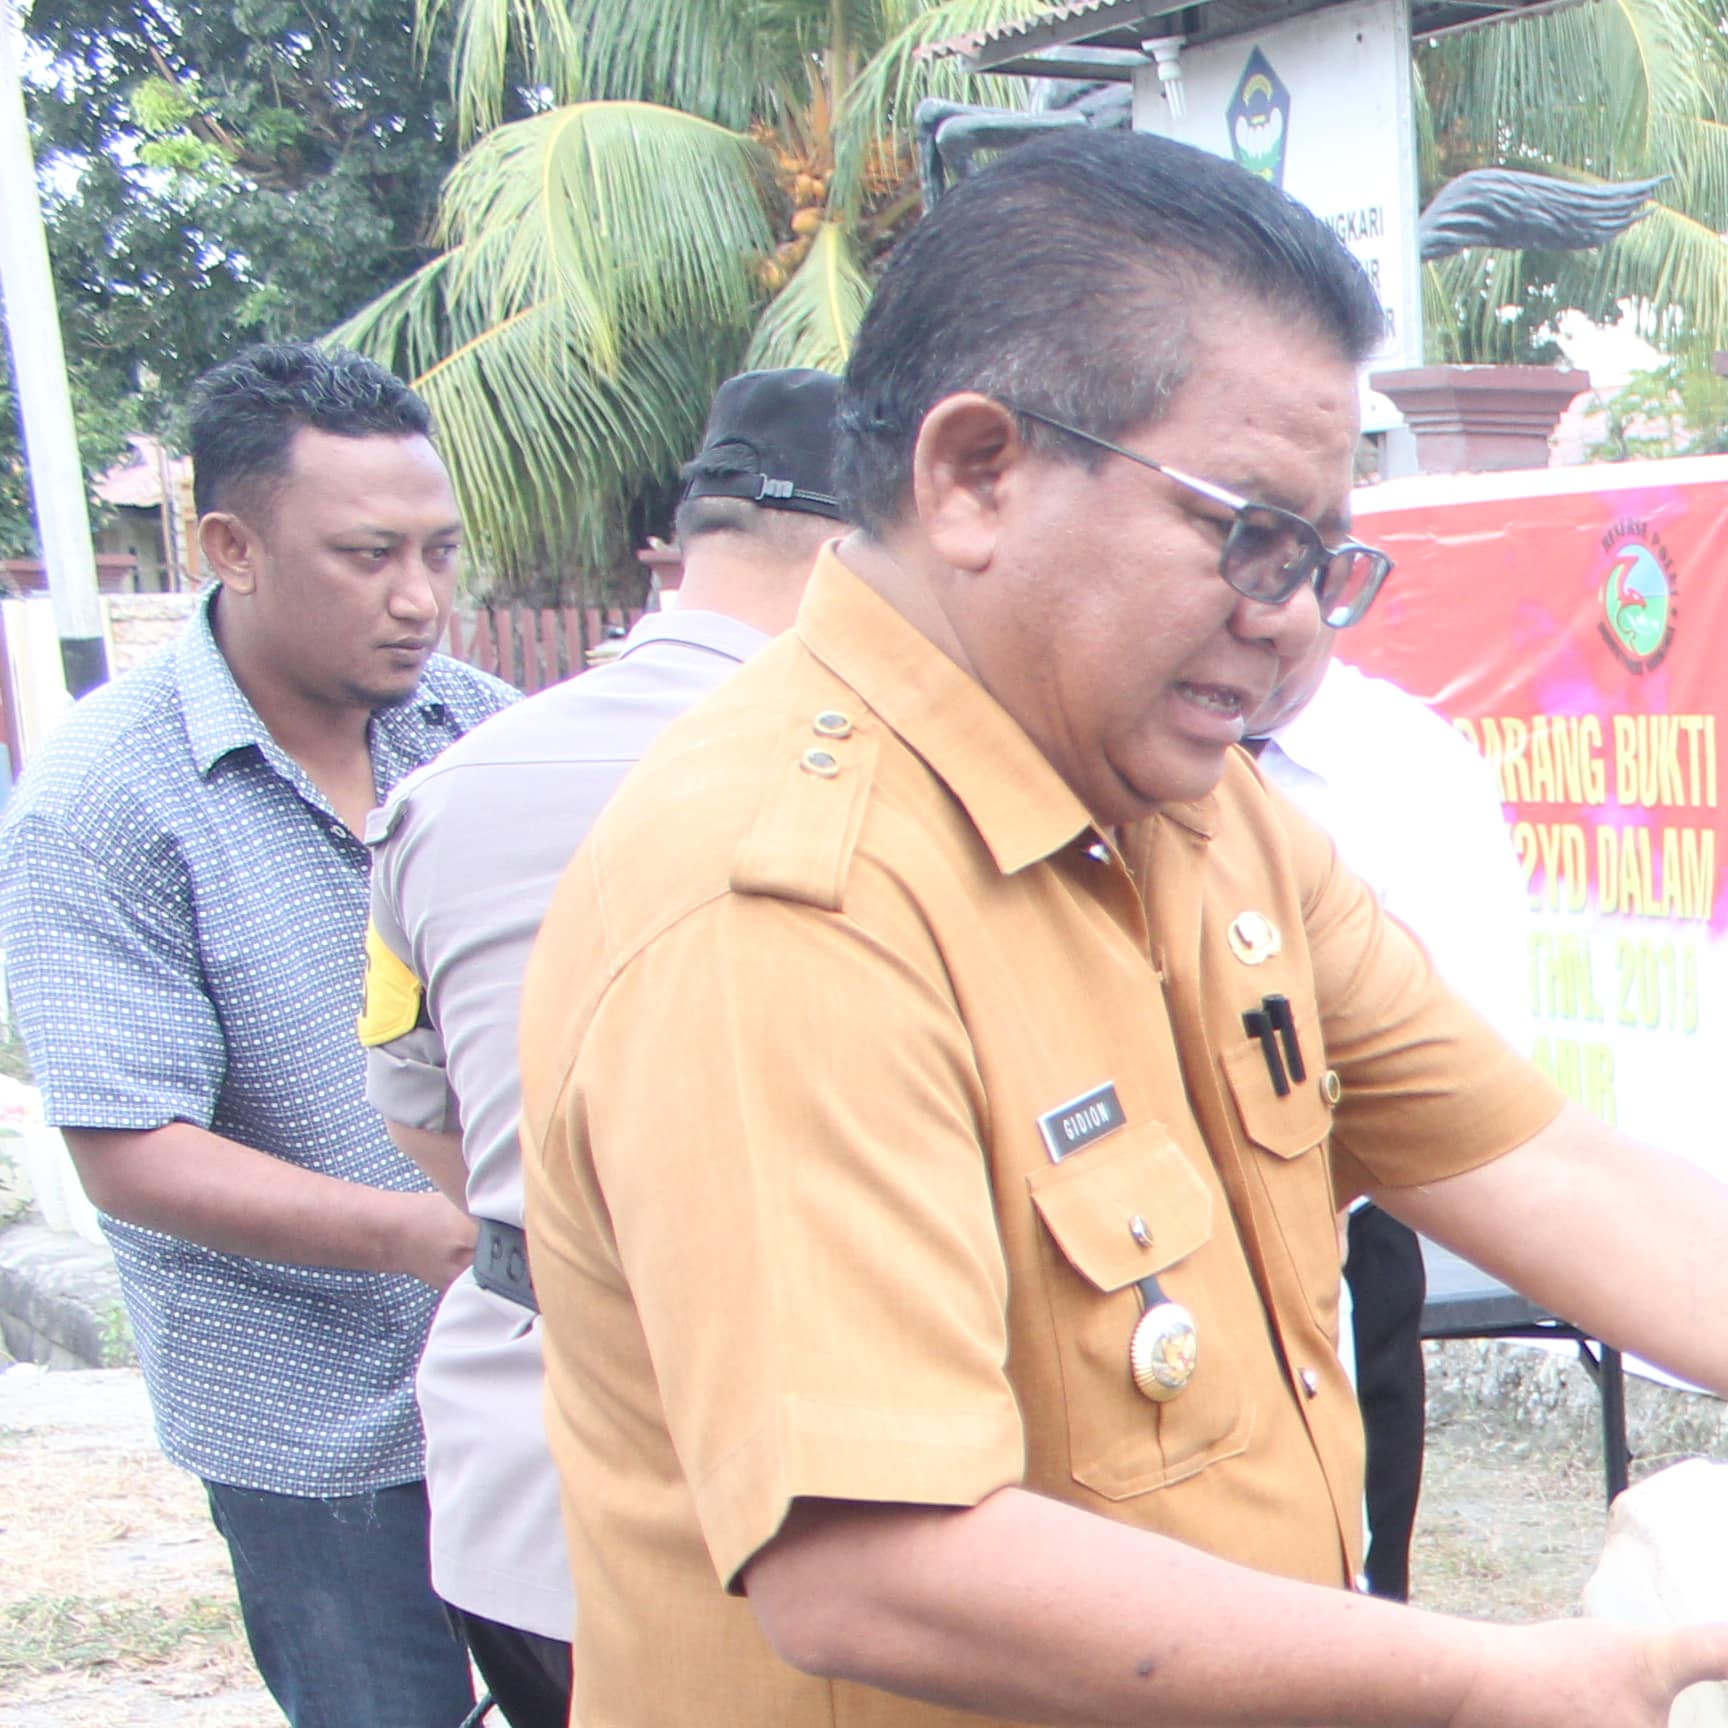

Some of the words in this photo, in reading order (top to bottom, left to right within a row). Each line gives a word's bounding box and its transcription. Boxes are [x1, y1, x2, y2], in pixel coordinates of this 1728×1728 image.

[1453, 715, 1605, 804] ARANG
[1614, 715, 1718, 808] BUKTI
[1597, 826, 1715, 920] DALAM
[1063, 1102, 1109, 1141] GIDION
